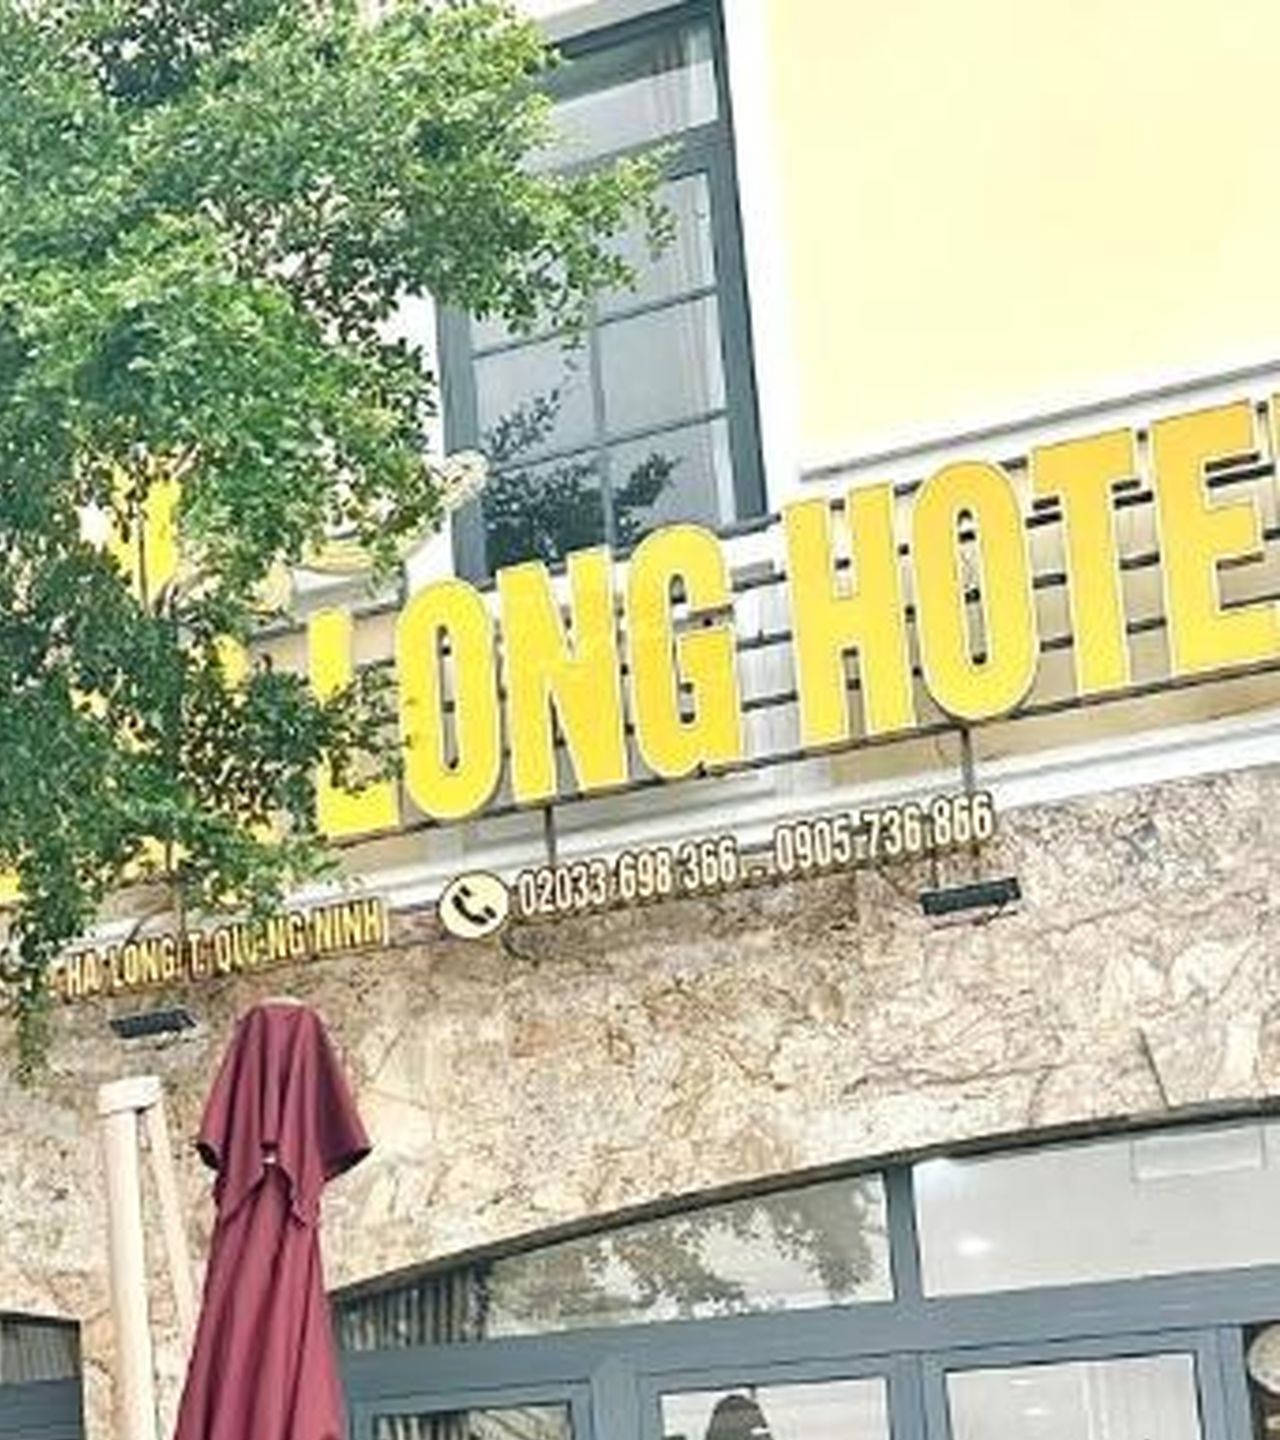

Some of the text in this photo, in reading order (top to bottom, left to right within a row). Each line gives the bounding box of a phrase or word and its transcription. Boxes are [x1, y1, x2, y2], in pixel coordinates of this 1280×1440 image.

[308, 522, 745, 840] LONG
[780, 392, 1280, 748] HOTE
[312, 896, 382, 952] NINH
[517, 858, 608, 918] 02033
[616, 846, 674, 900] 698
[680, 836, 738, 892] 366
[774, 816, 853, 882] 0905
[862, 802, 924, 860] 736
[930, 790, 996, 848] 866
